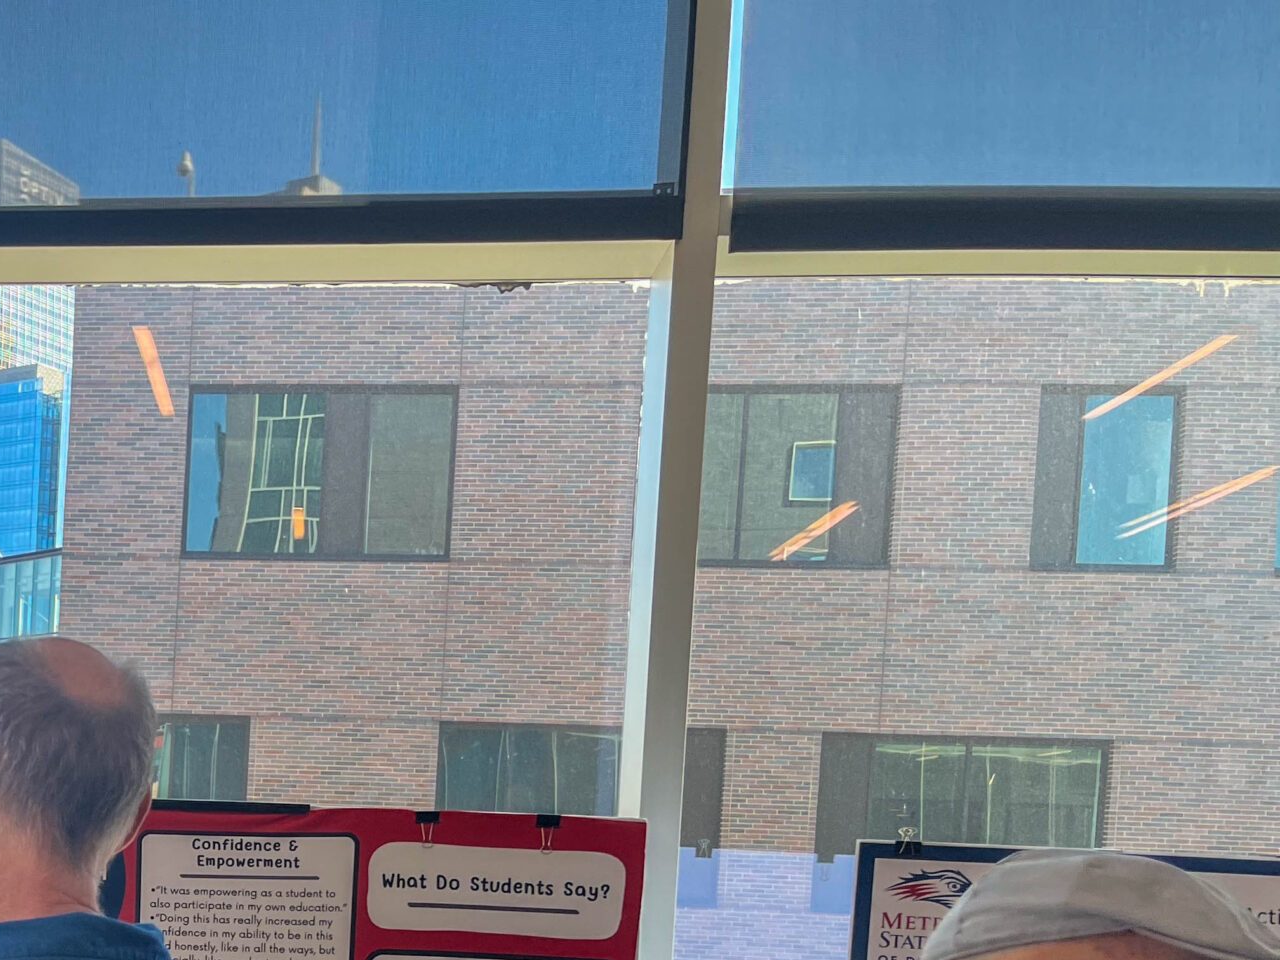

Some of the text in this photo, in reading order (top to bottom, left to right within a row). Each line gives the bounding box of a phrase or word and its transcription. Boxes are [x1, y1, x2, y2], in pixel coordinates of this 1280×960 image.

[192, 838, 298, 852] Confidence &
[197, 855, 300, 870] Empowerment
[194, 886, 258, 901] empowering
[286, 887, 323, 899] student
[382, 873, 610, 901] What Do Students Say?
[150, 898, 171, 909] also
[174, 899, 233, 914] participate
[193, 912, 210, 924] this
[213, 913, 231, 924] has
[233, 914, 262, 929] really
[265, 915, 316, 926] increased
[162, 926, 333, 943] nfidence ability this
[879, 931, 928, 949] STAT
[221, 941, 239, 953] like
[254, 942, 267, 953] all
[269, 943, 286, 954] the
[319, 944, 336, 955] but
